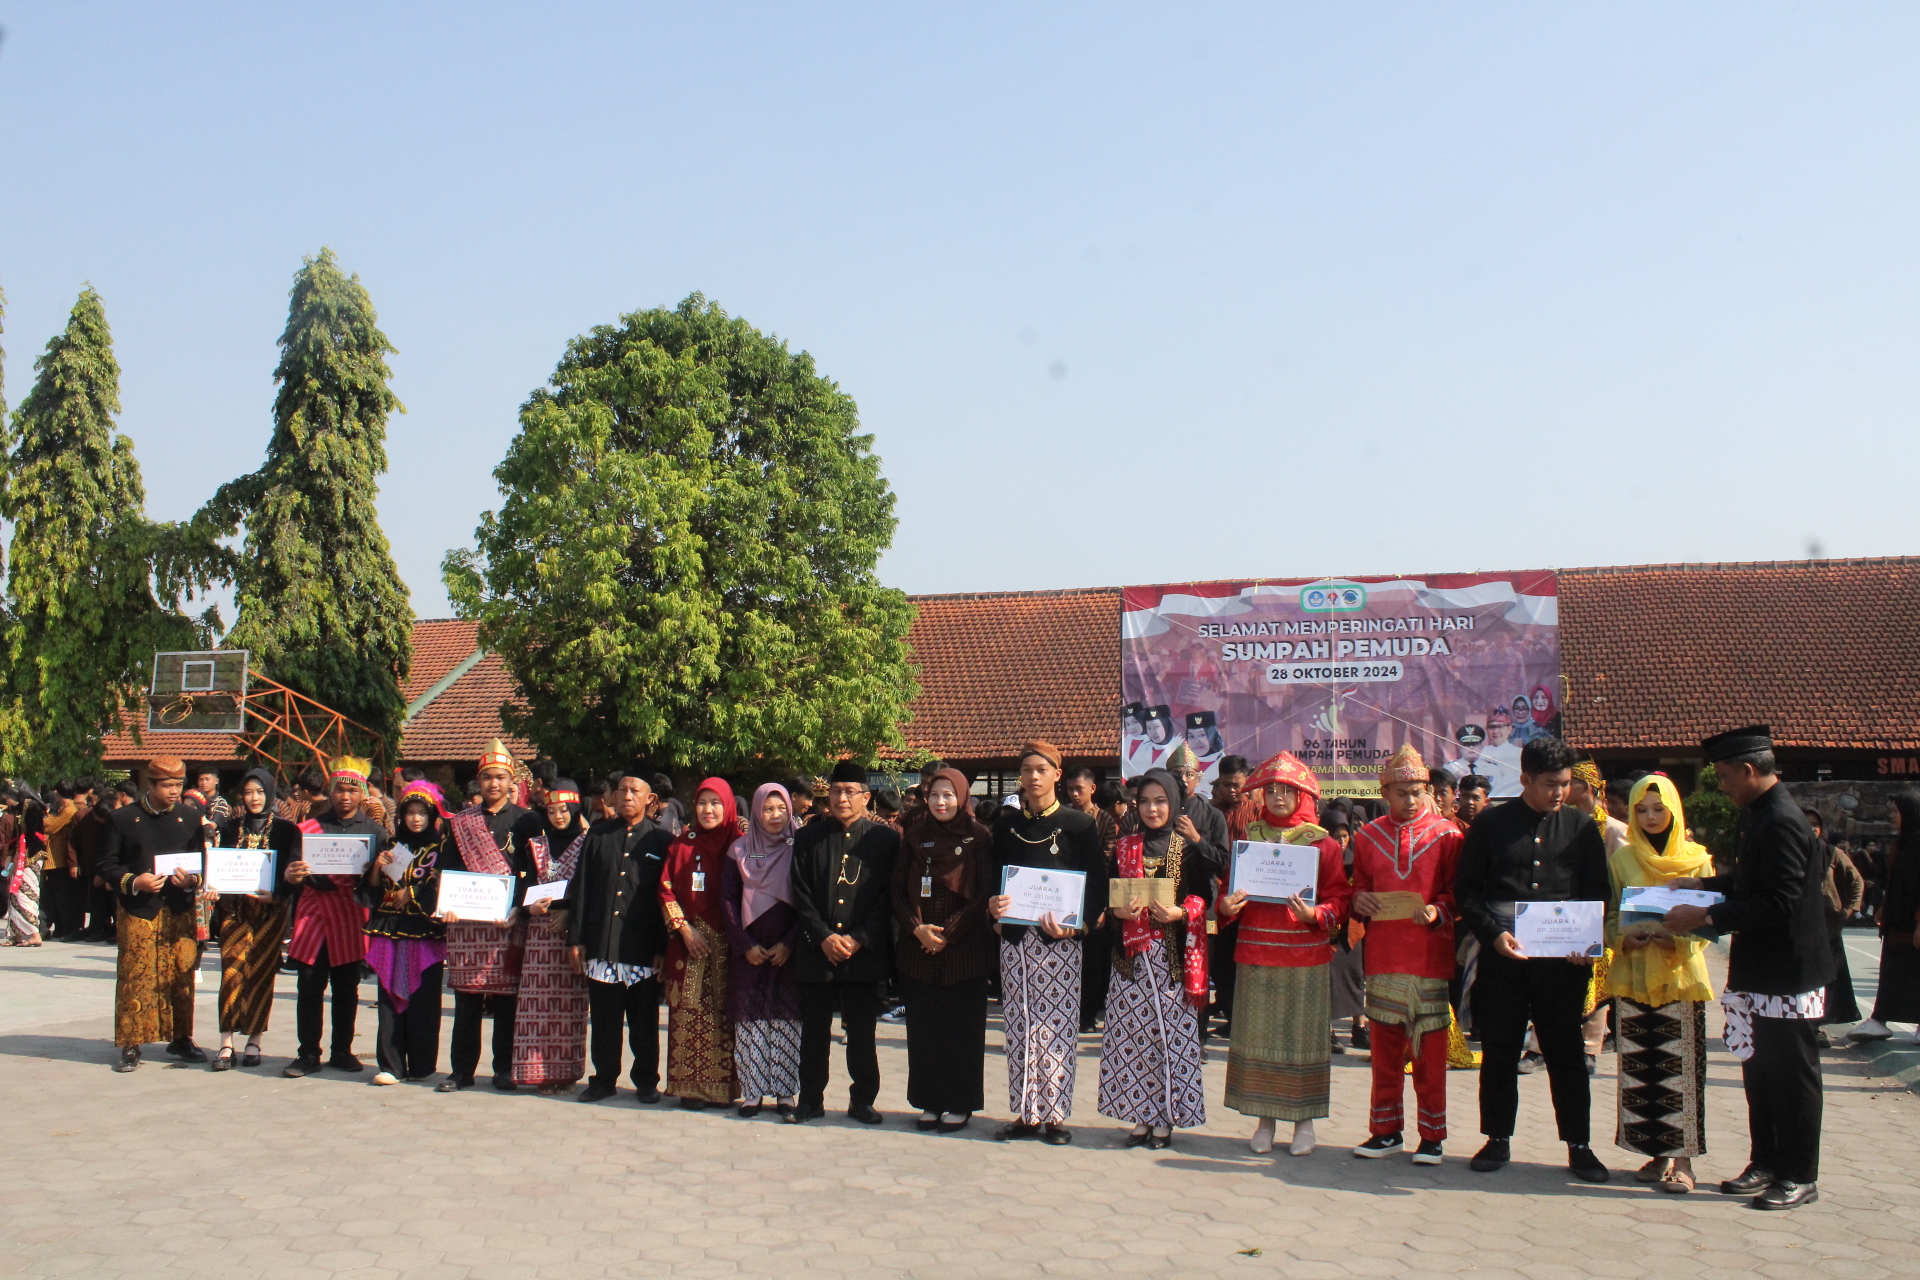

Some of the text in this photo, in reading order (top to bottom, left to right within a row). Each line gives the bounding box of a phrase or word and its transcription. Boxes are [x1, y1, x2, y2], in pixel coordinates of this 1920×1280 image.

[1198, 616, 1475, 638] SELAMAT MEMPERINGATI HARI
[1221, 636, 1451, 661] SUMPAH PEMUDA
[1271, 665, 1398, 680] 28 OKTOBER 2024
[1303, 738, 1367, 749] 96 TAHUN
[1336, 749, 1391, 760] PEMUDA
[1877, 757, 1920, 775] SMA
[1029, 884, 1053, 892] JUARA
